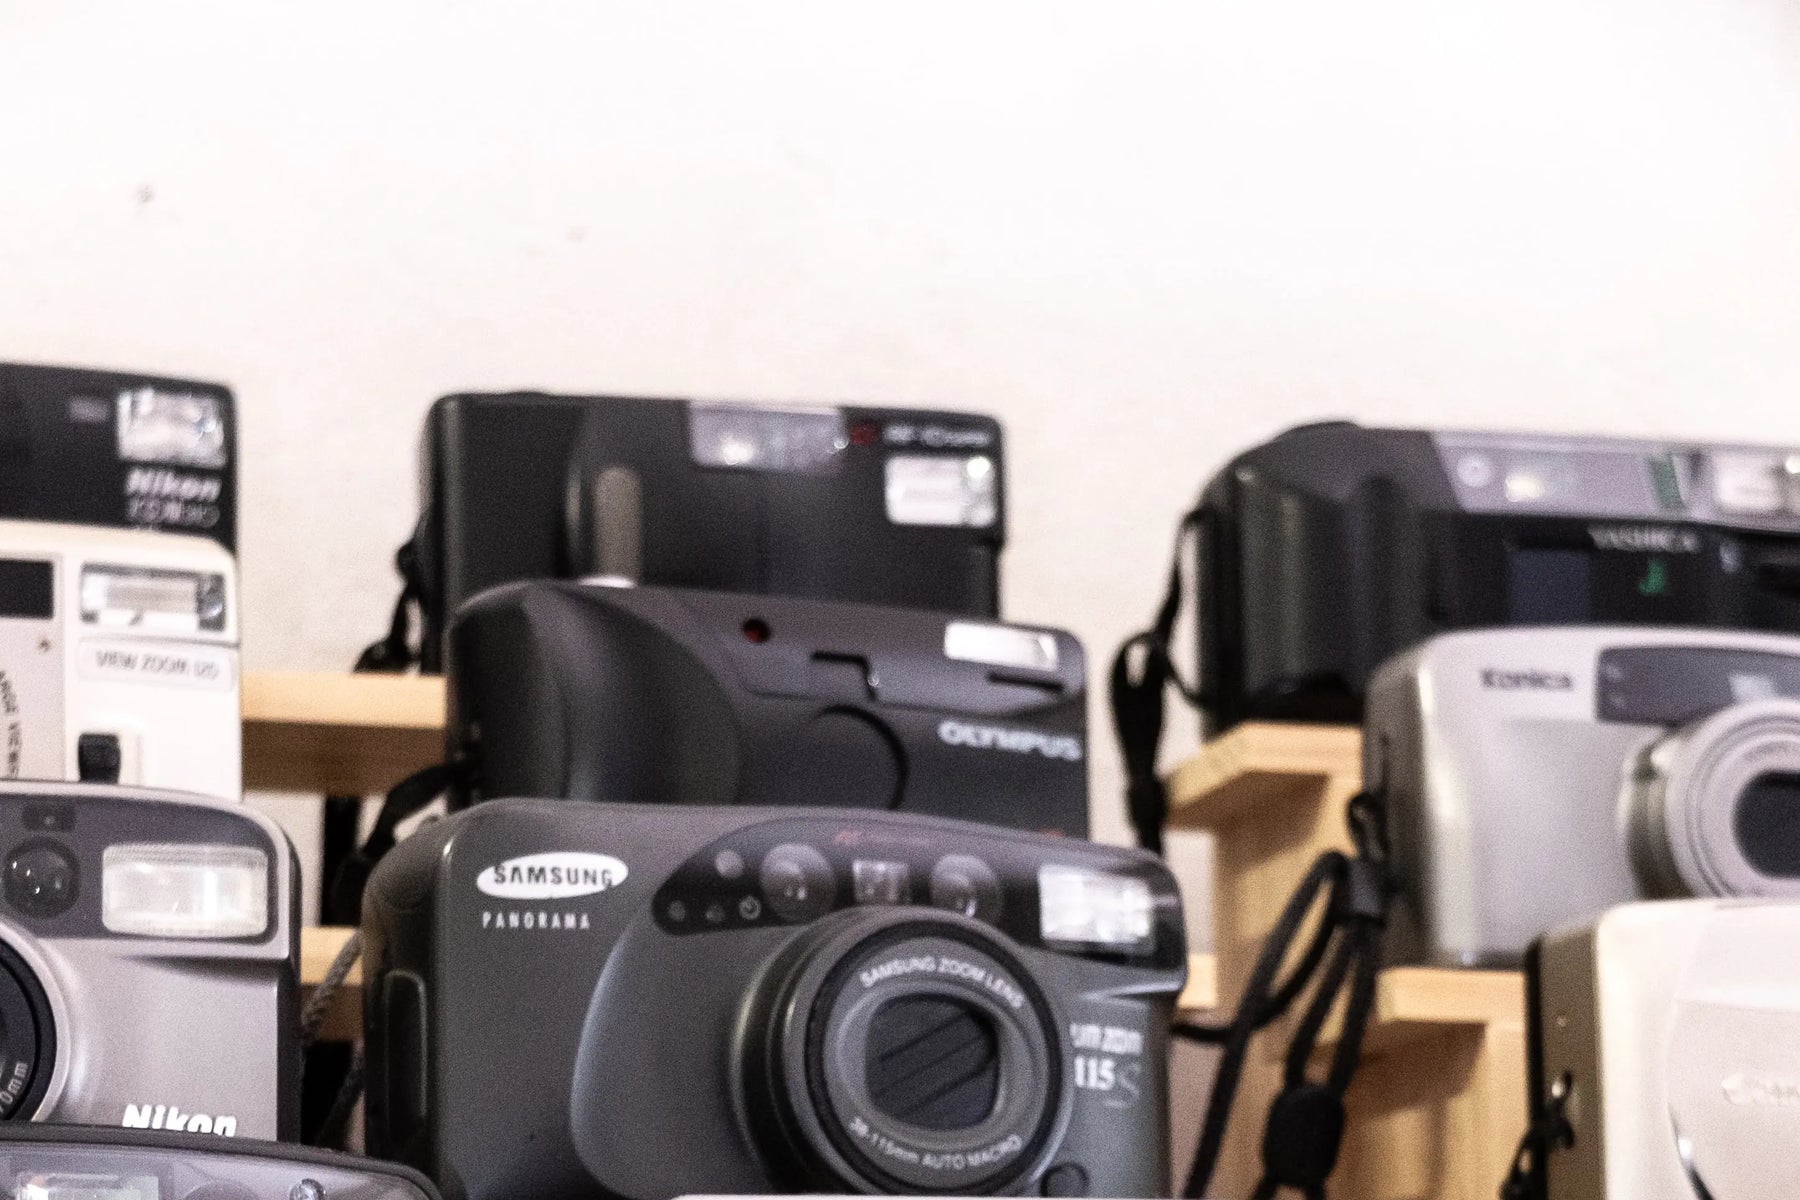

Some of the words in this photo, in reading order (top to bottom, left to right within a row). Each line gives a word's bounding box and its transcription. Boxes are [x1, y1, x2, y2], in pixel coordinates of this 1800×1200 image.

[1482, 668, 1573, 691] Konica
[937, 721, 1082, 761] OLYMPUS
[493, 864, 613, 888] SAMSUNG
[482, 911, 590, 929] PANORAMA
[860, 956, 936, 987] SAMSUNG
[937, 957, 986, 981] ZOOM
[122, 1104, 236, 1137] Nikon
[922, 1152, 966, 1170] AUTO
